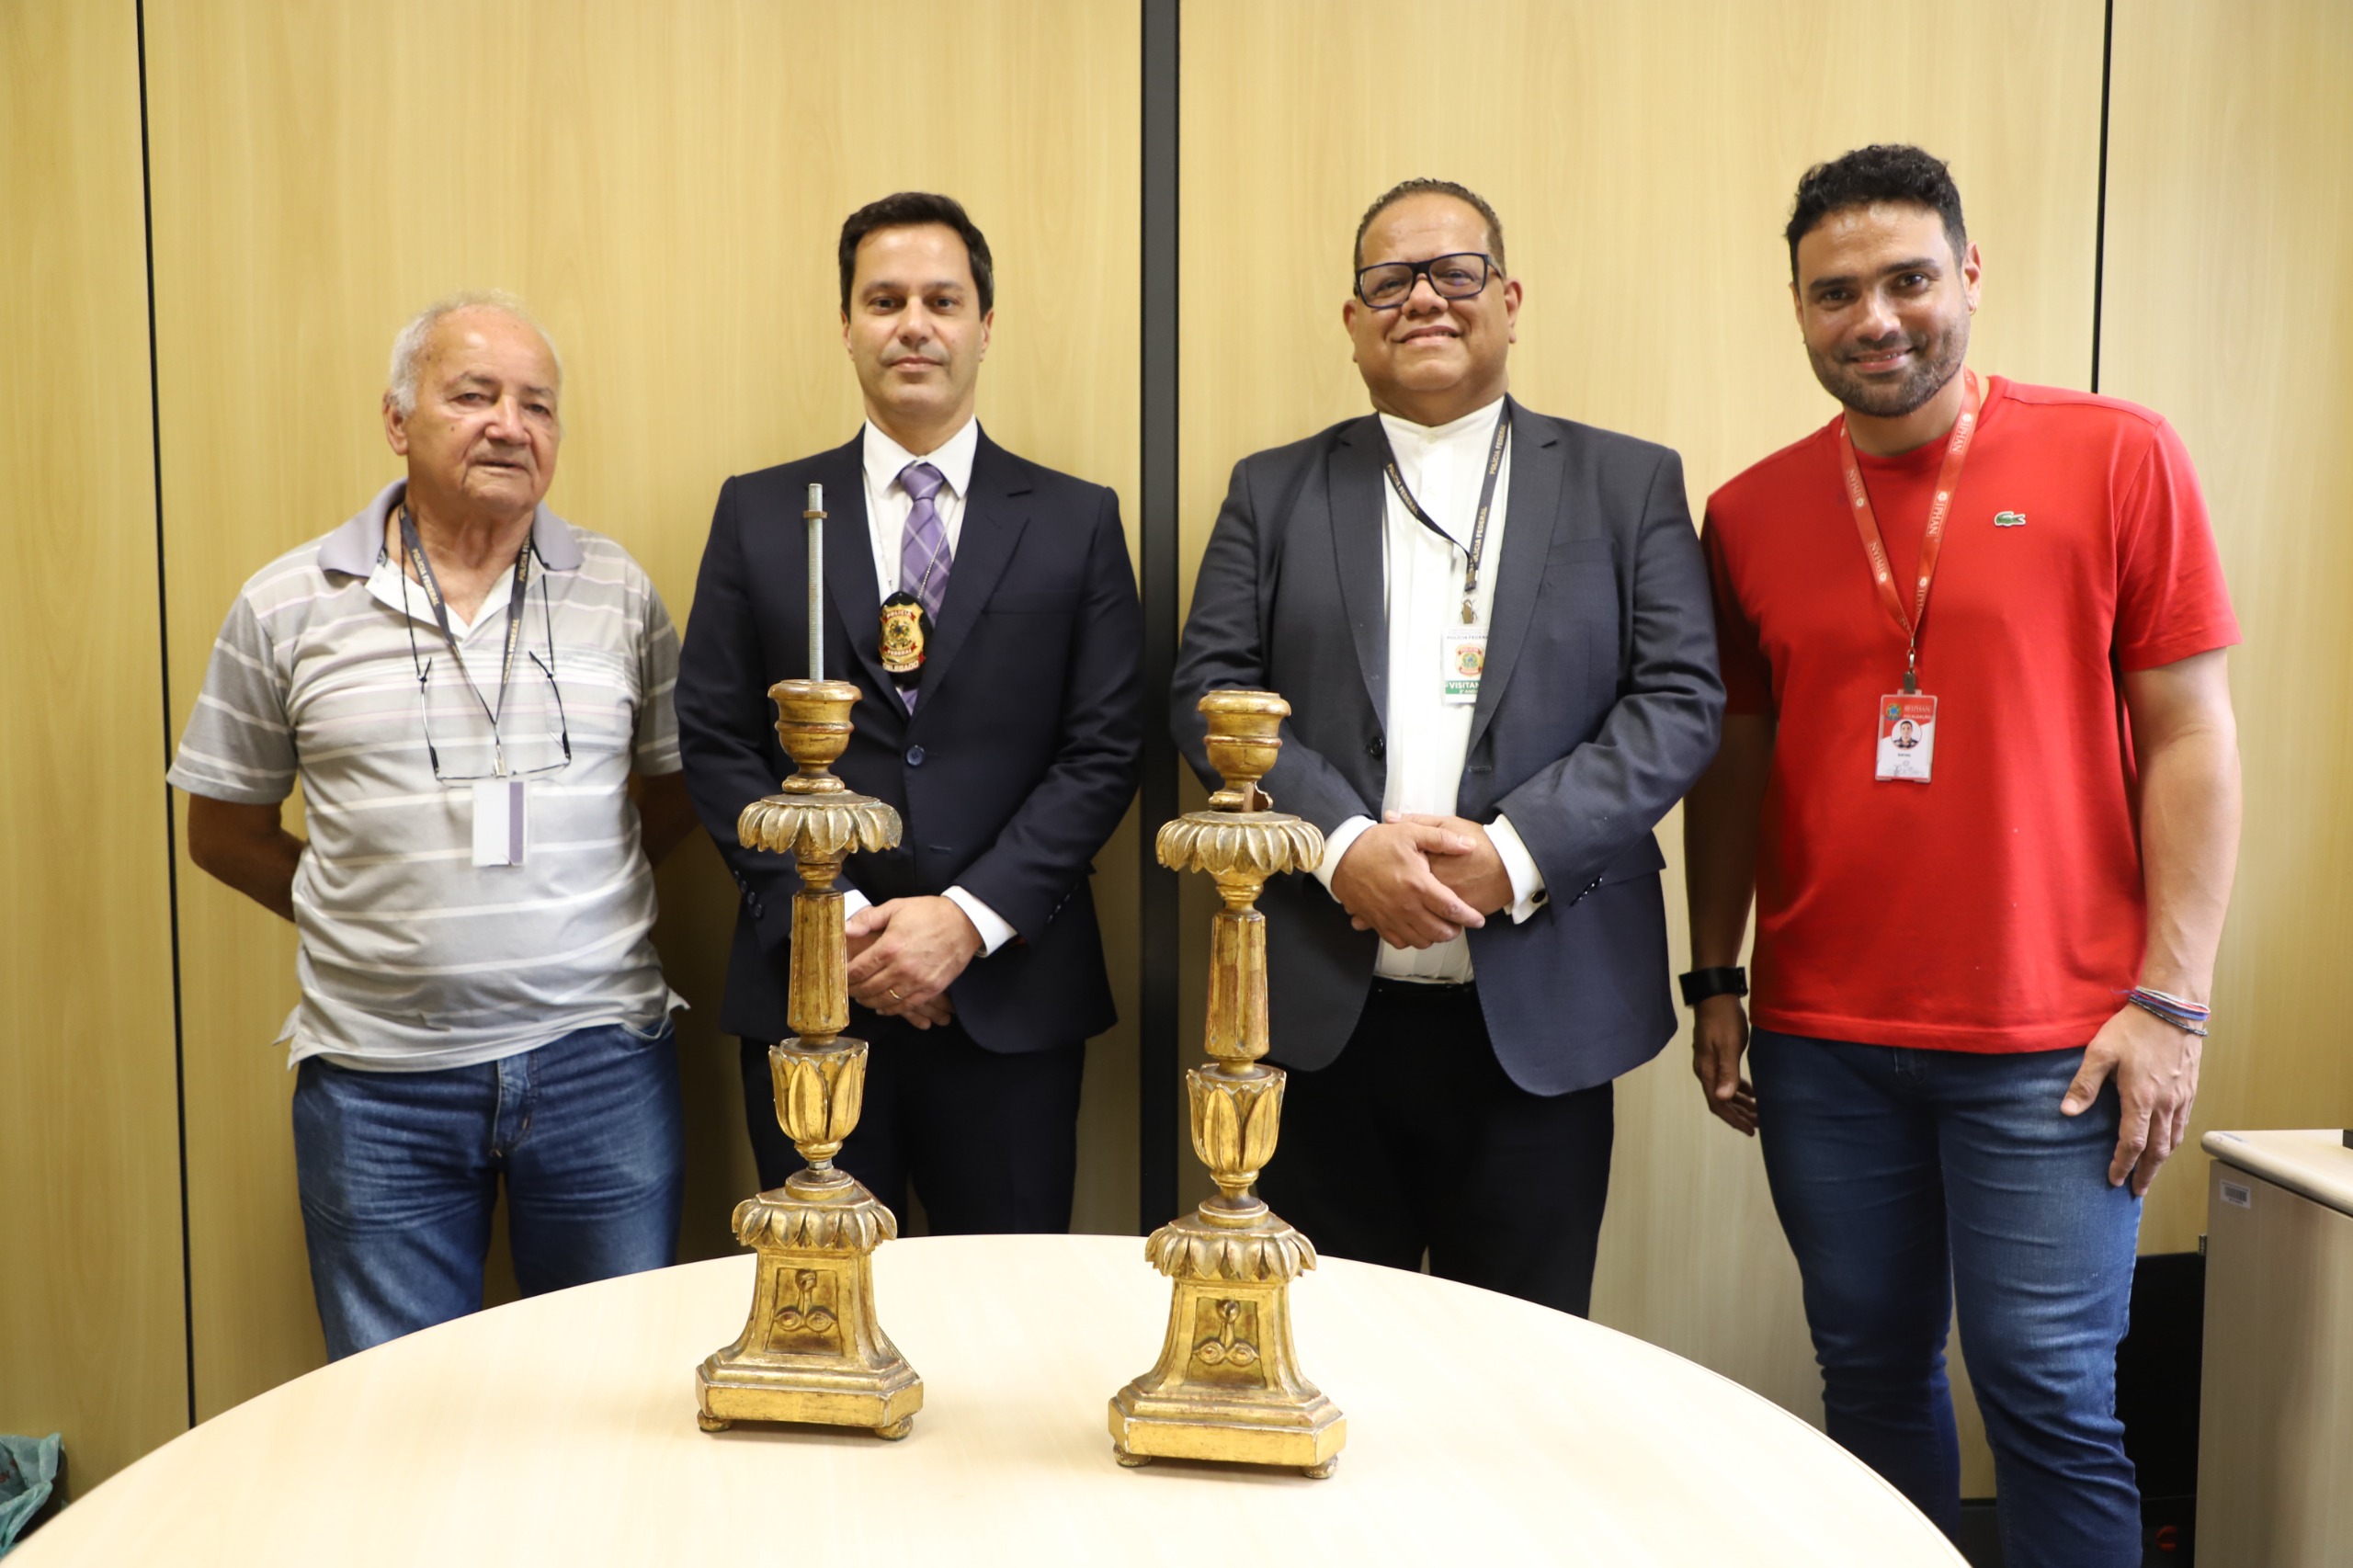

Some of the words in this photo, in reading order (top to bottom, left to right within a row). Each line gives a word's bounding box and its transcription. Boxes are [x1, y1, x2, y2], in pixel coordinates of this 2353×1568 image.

[1495, 424, 1506, 450] FEDERAL
[1952, 423, 1970, 453] IPHAN
[1847, 469, 1863, 498] IPHAN
[1398, 485, 1418, 515] FEDERAL
[1476, 506, 1488, 537] FEDERAL
[1928, 503, 1946, 536] IPHAN
[1870, 541, 1885, 573] IPHAN
[423, 574, 439, 607] FEDERAL
[508, 618, 520, 653] FEDERAL
[888, 648, 912, 656] FEDERAL
